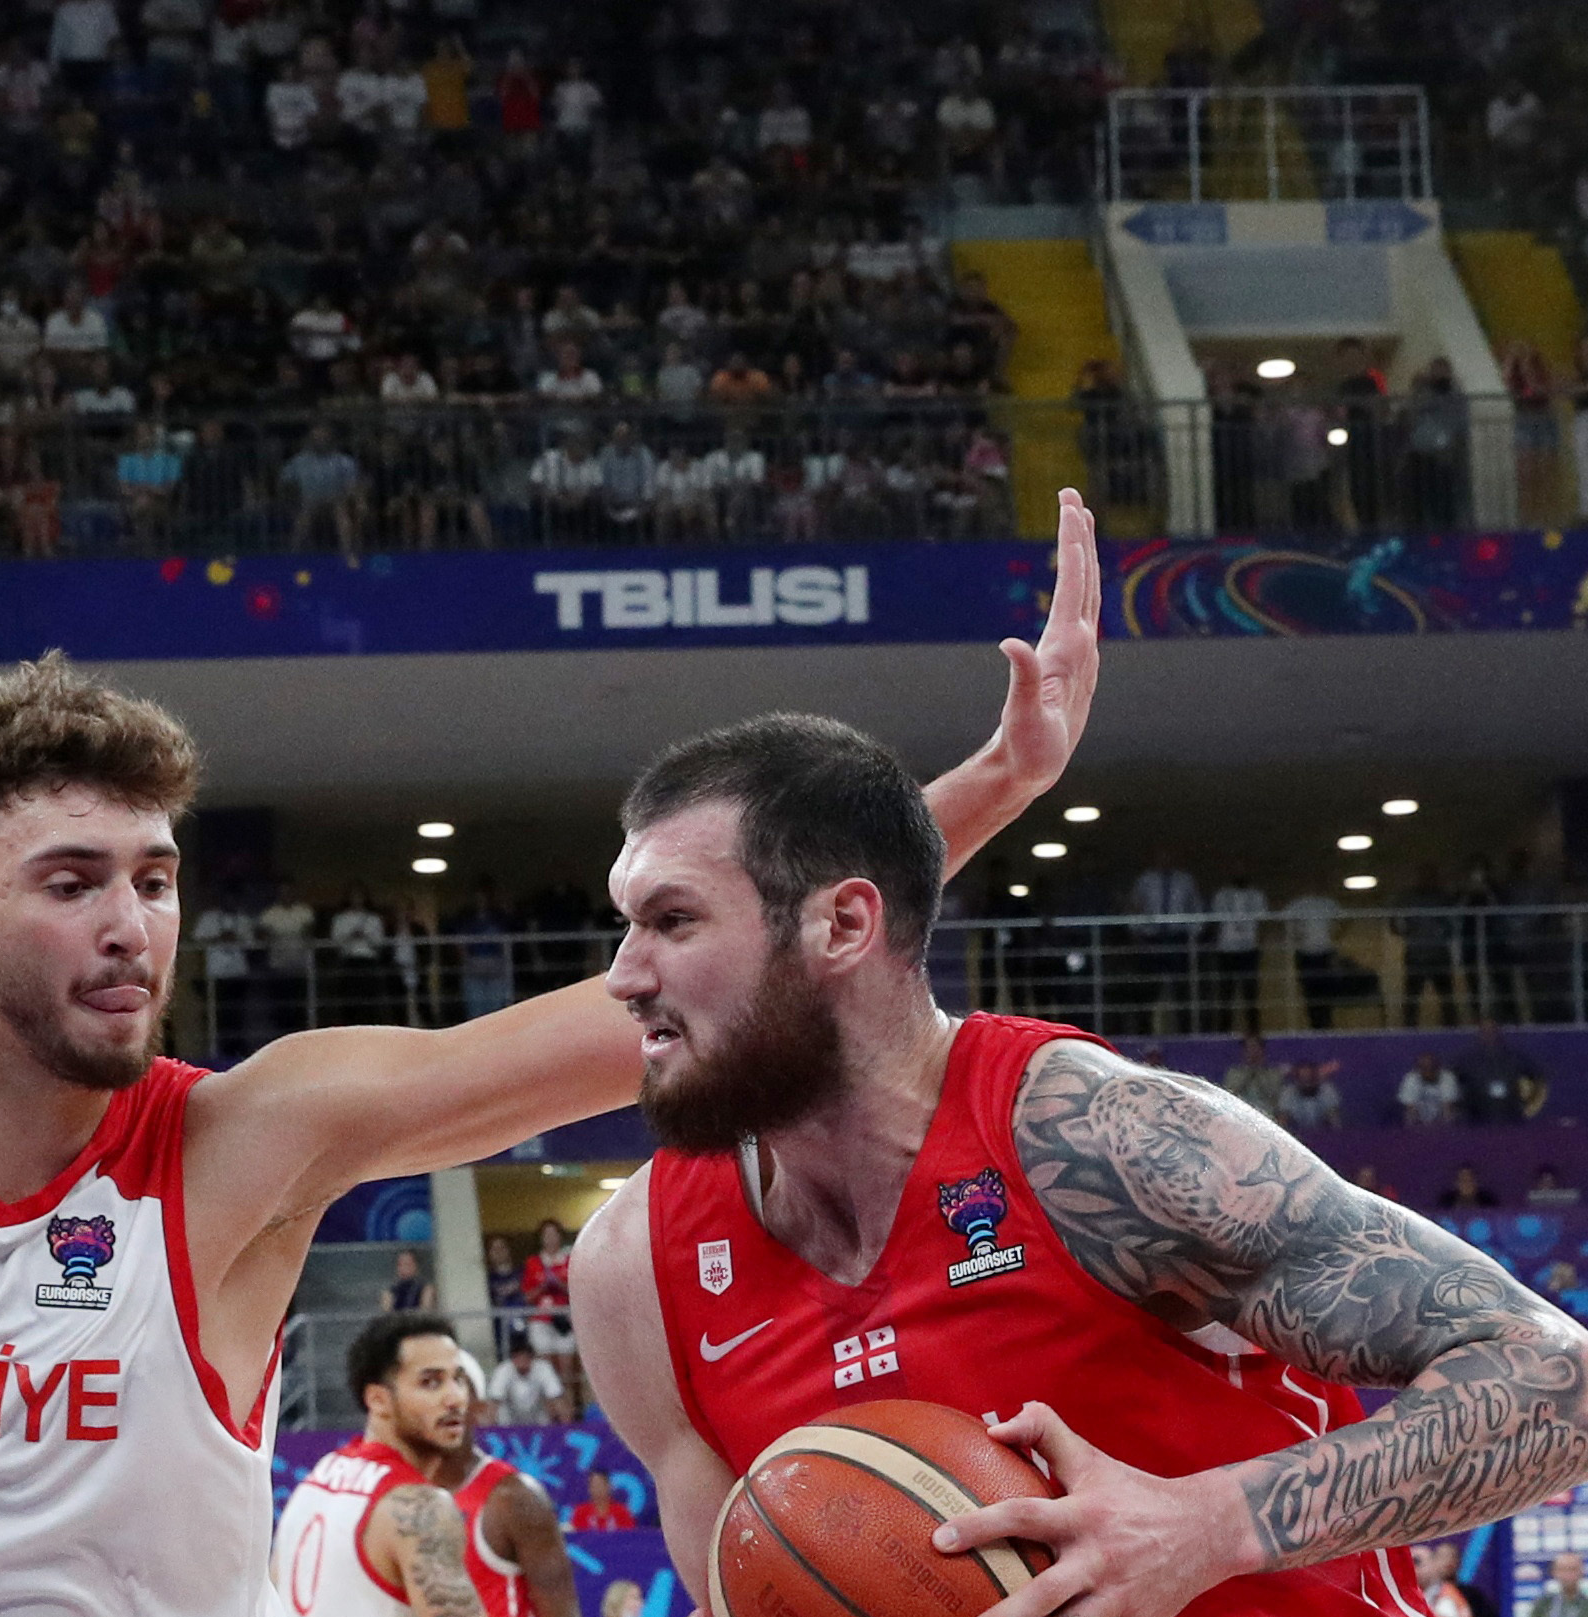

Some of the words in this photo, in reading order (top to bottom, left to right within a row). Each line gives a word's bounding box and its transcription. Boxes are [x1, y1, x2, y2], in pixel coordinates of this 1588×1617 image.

[533, 565, 869, 630] TBILISI
[38, 1286, 111, 1302] EUROBASKE
[949, 1246, 1023, 1280] EUROBASKET
[290, 1513, 325, 1617] 0
[876, 1532, 964, 1614] EUROBASKET
